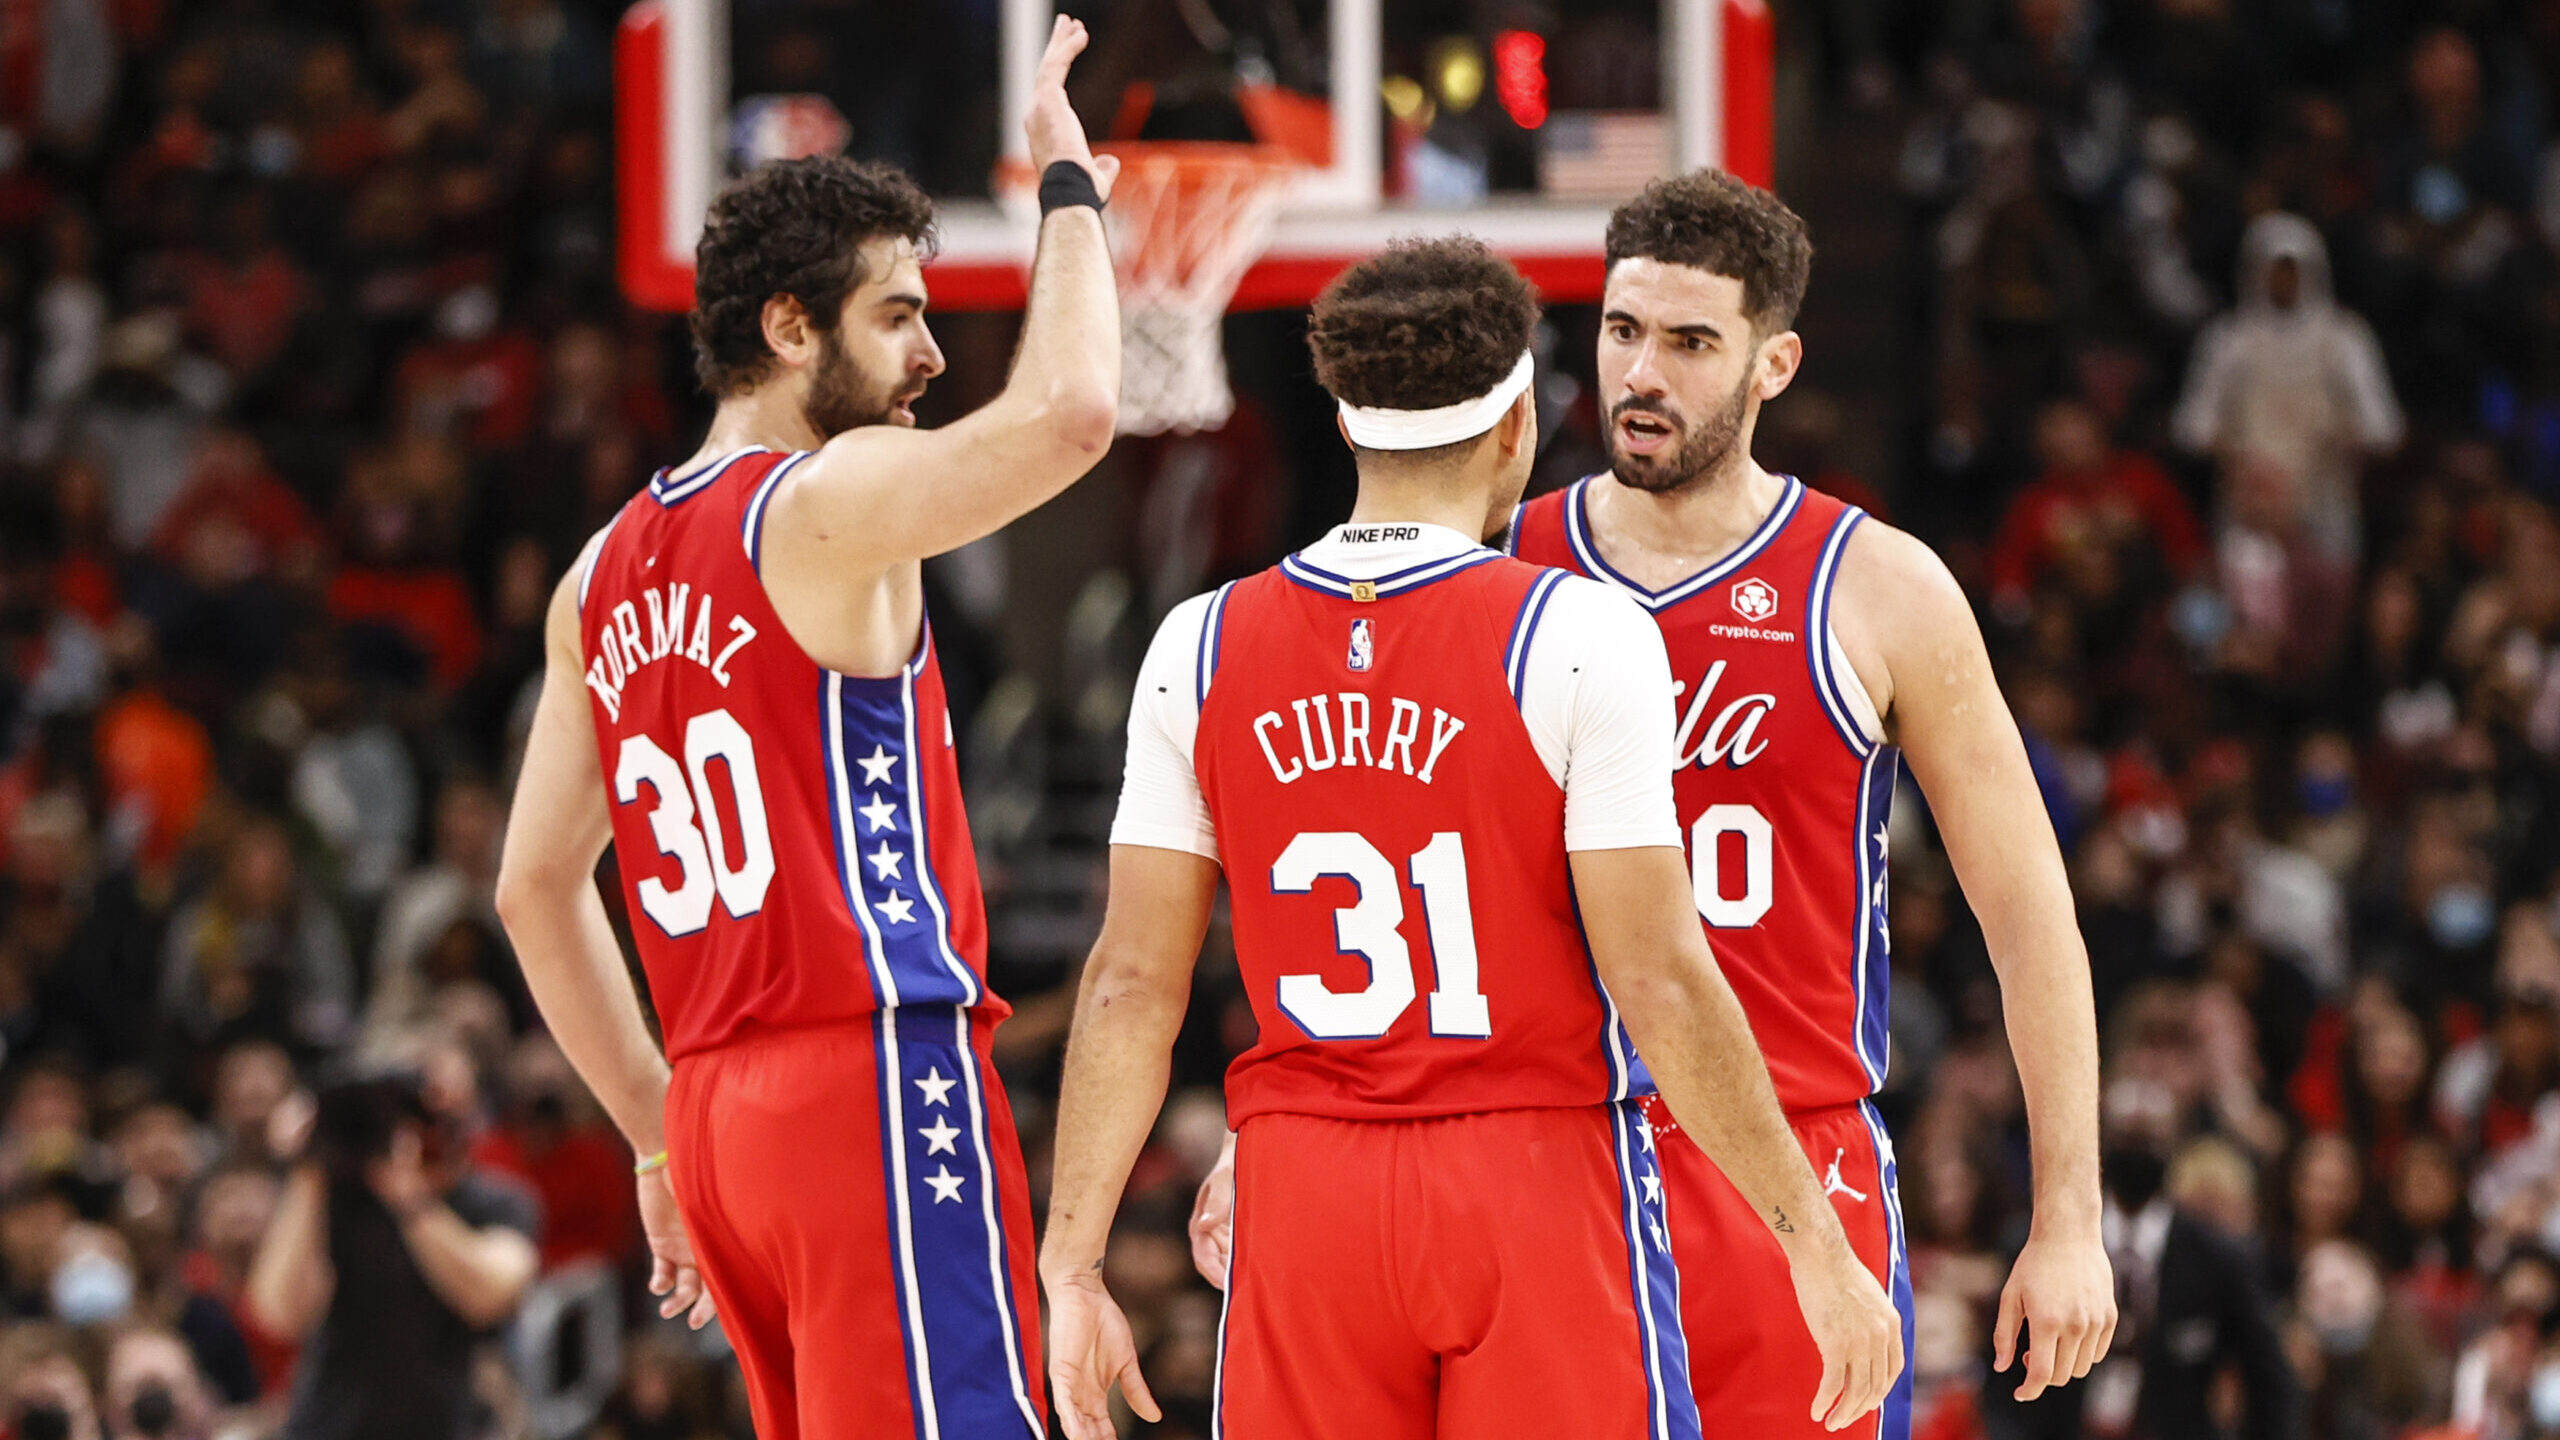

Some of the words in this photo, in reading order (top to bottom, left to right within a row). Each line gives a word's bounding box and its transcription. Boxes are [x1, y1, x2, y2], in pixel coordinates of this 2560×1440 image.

[1340, 528, 1380, 543] NIKE
[1382, 527, 1420, 541] PRO
[1709, 623, 1795, 643] crypto.com
[1253, 692, 1465, 784] CURRY
[615, 708, 776, 939] 30
[1691, 803, 1774, 930] 0
[1270, 831, 1492, 1041] 31
